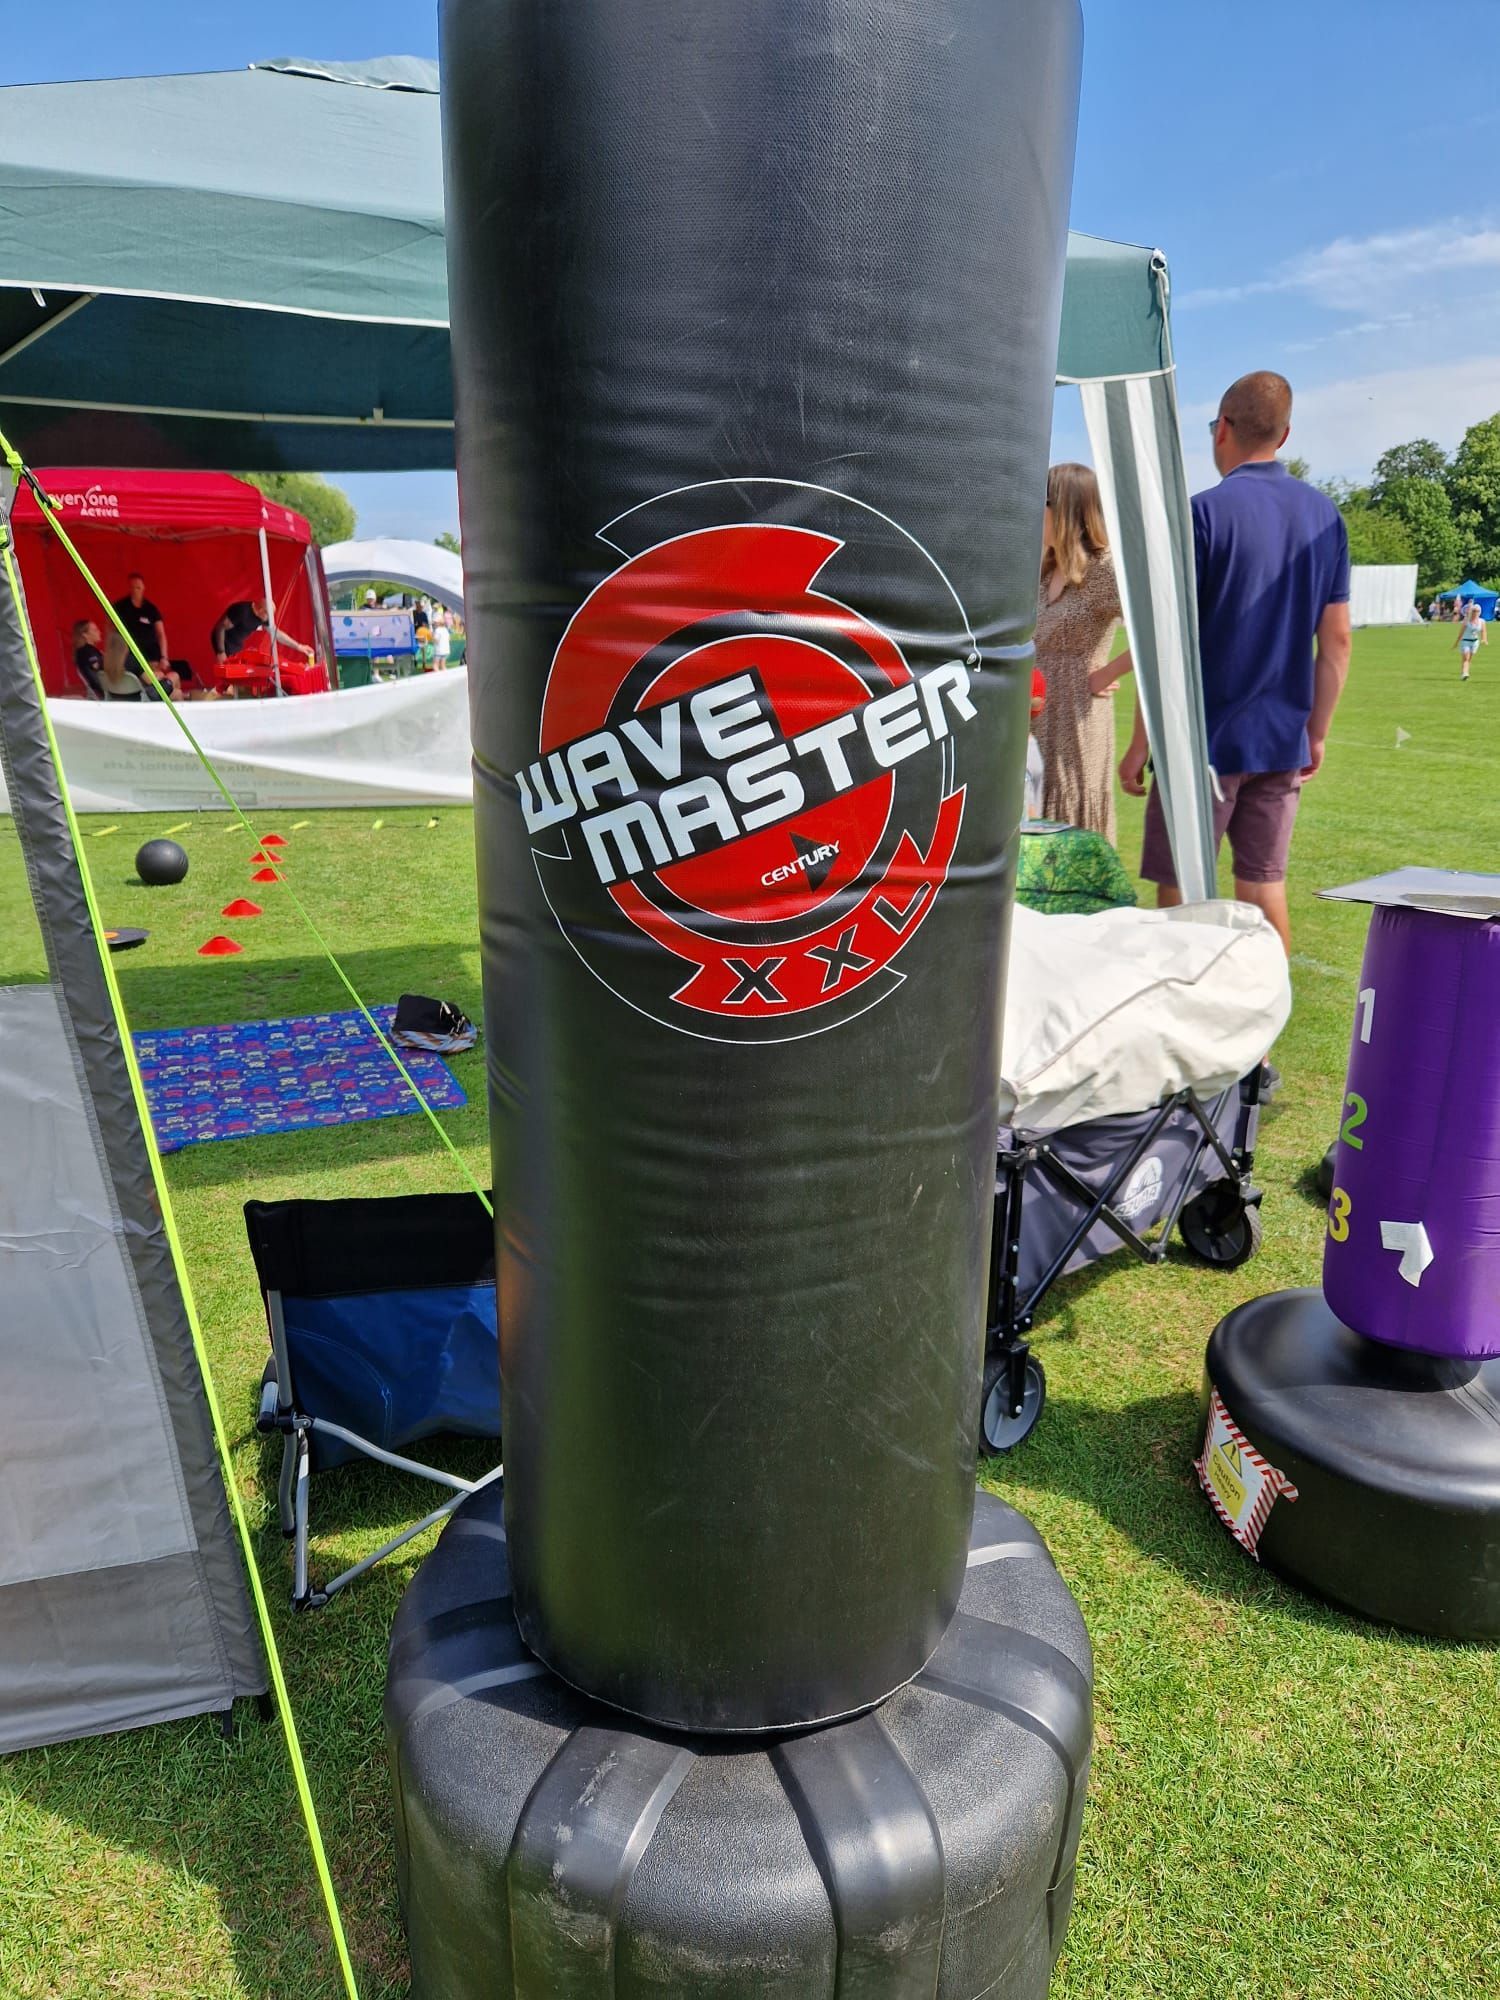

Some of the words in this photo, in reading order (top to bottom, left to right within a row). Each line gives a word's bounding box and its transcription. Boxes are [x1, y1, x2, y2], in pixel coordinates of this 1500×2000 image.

[80, 507, 120, 518] ACTIVE
[514, 673, 775, 834] WAVE
[581, 659, 978, 884] MASTER
[760, 840, 841, 888] CENTURY
[1359, 988, 1376, 1044] 1
[1340, 1091, 1368, 1150] 2
[1328, 1186, 1352, 1242] 3
[1212, 1453, 1241, 1501] Caution
